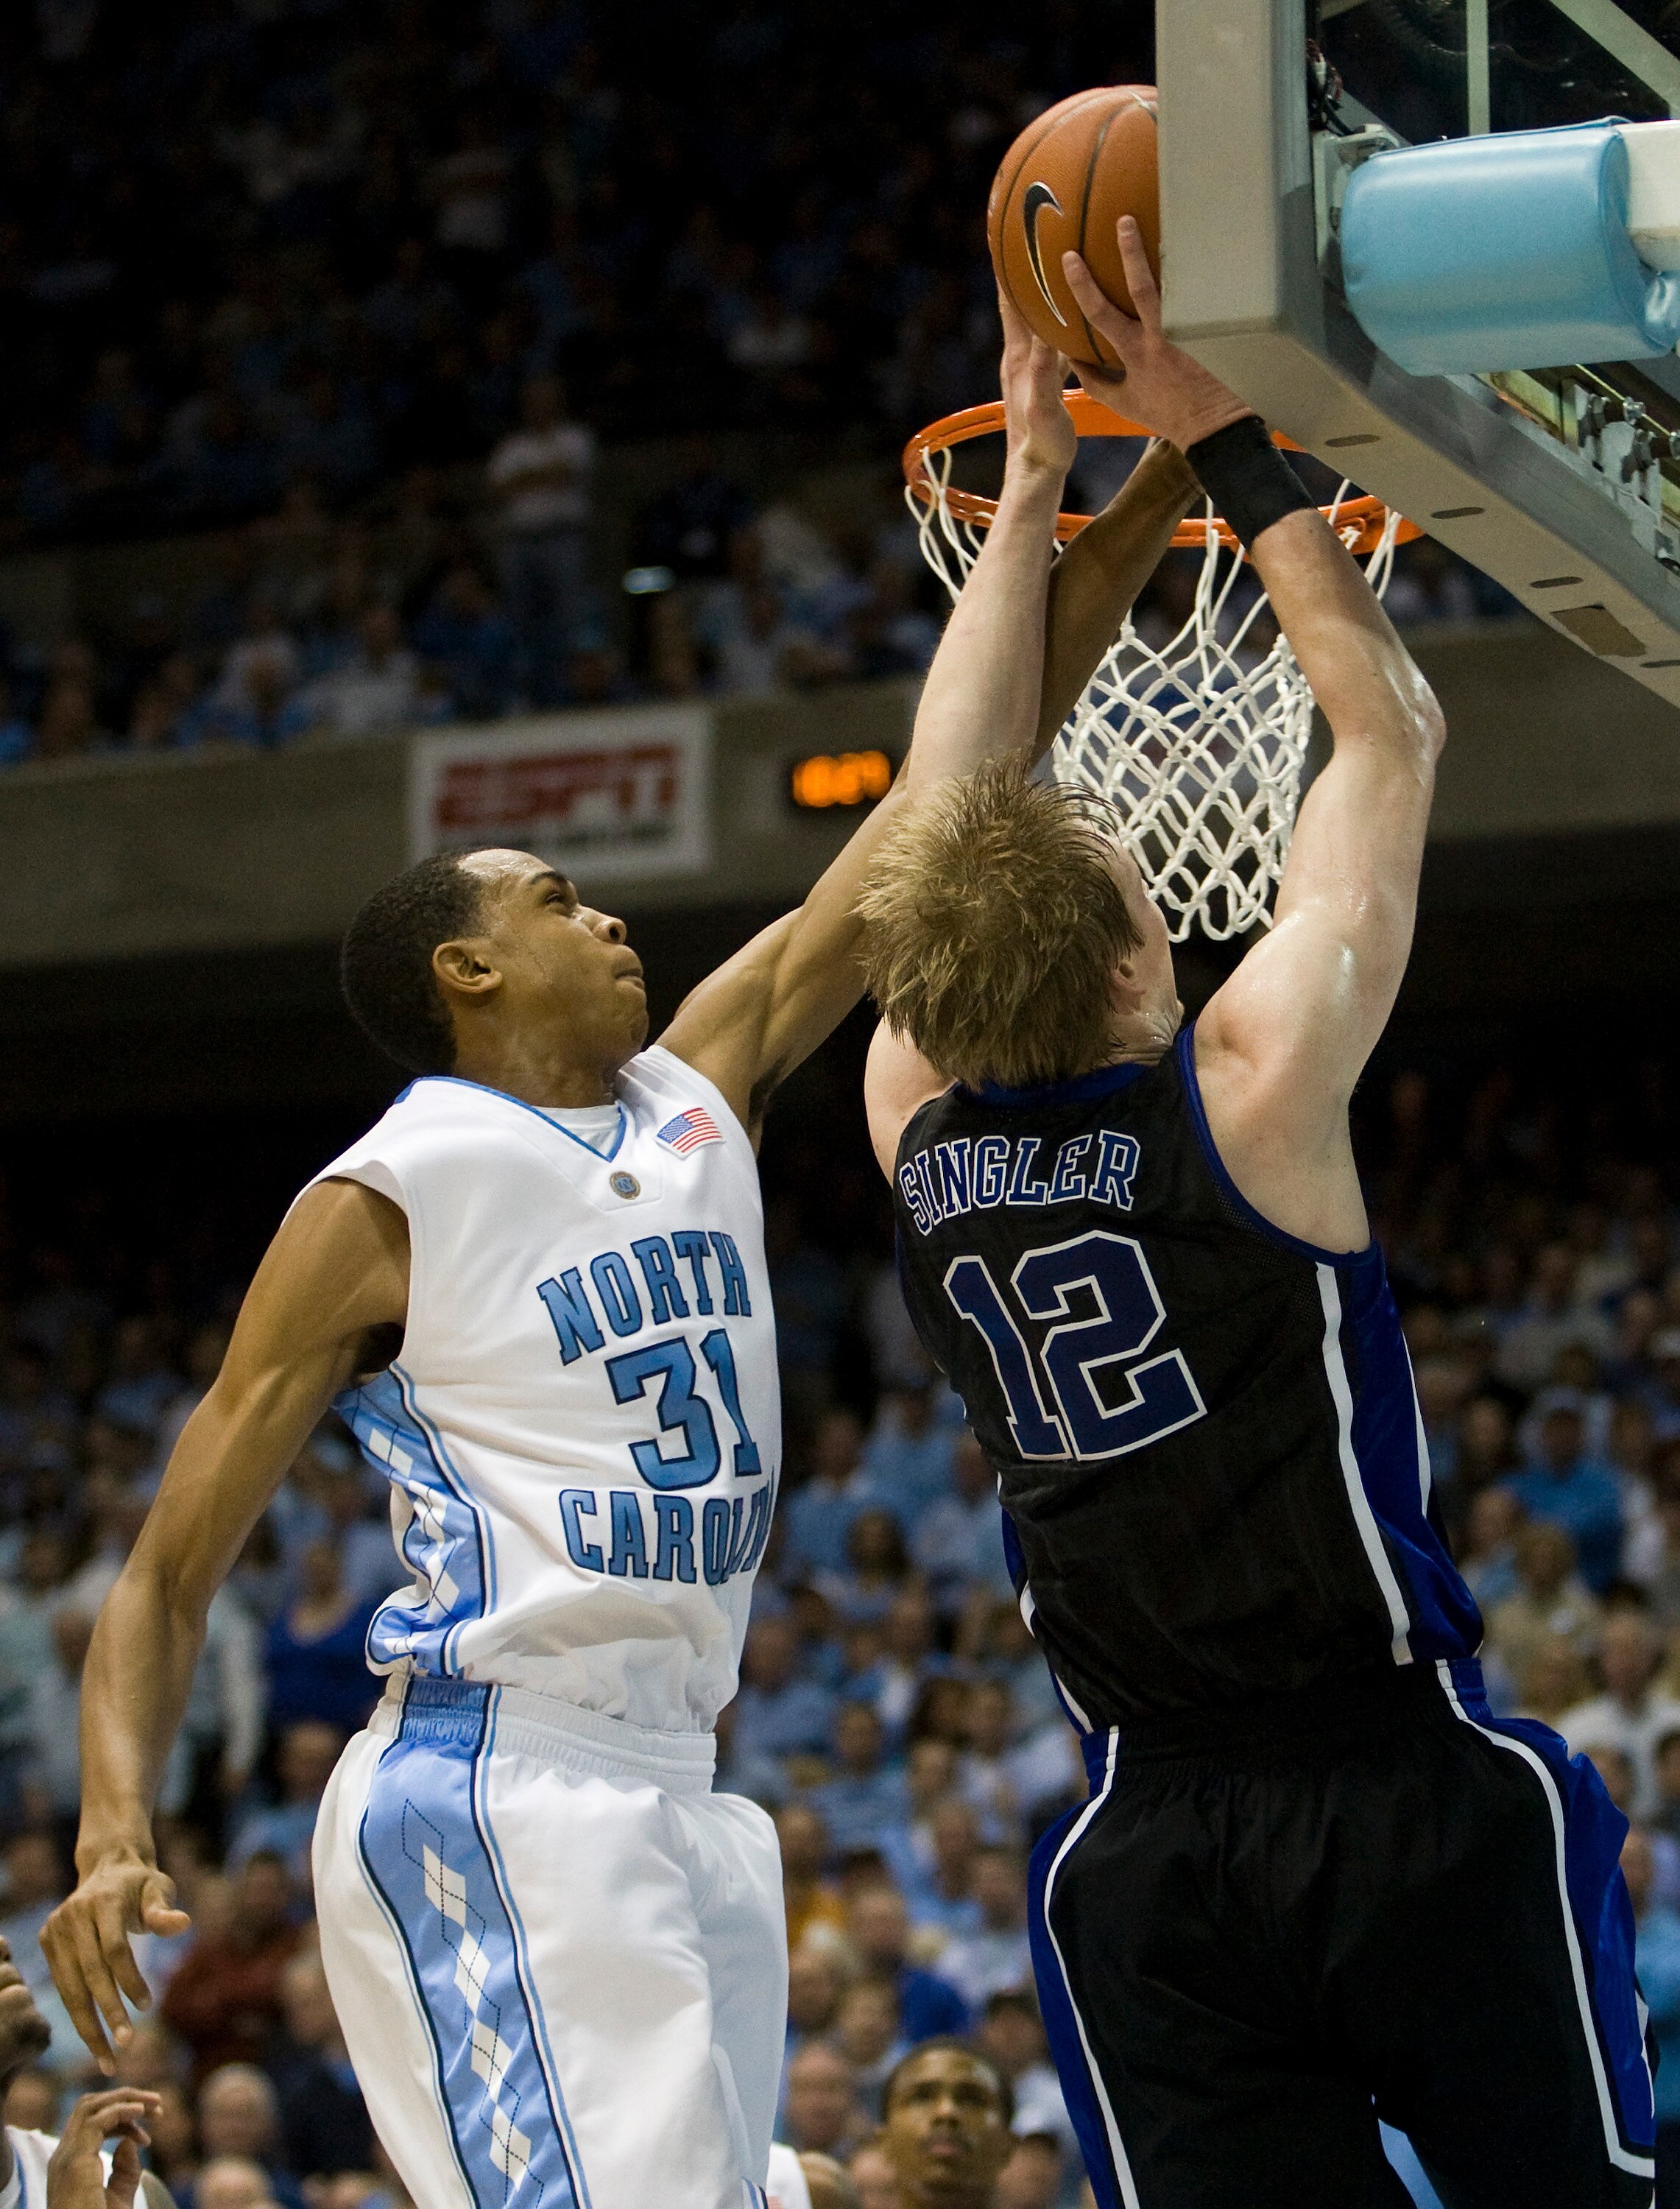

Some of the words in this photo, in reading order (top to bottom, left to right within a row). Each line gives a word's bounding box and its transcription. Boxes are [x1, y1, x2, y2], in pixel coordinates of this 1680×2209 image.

[898, 1130, 1140, 1236] SINGLER
[536, 1230, 752, 1367] NORTH
[942, 1229, 1208, 1462] 12
[604, 1328, 762, 1492] 31
